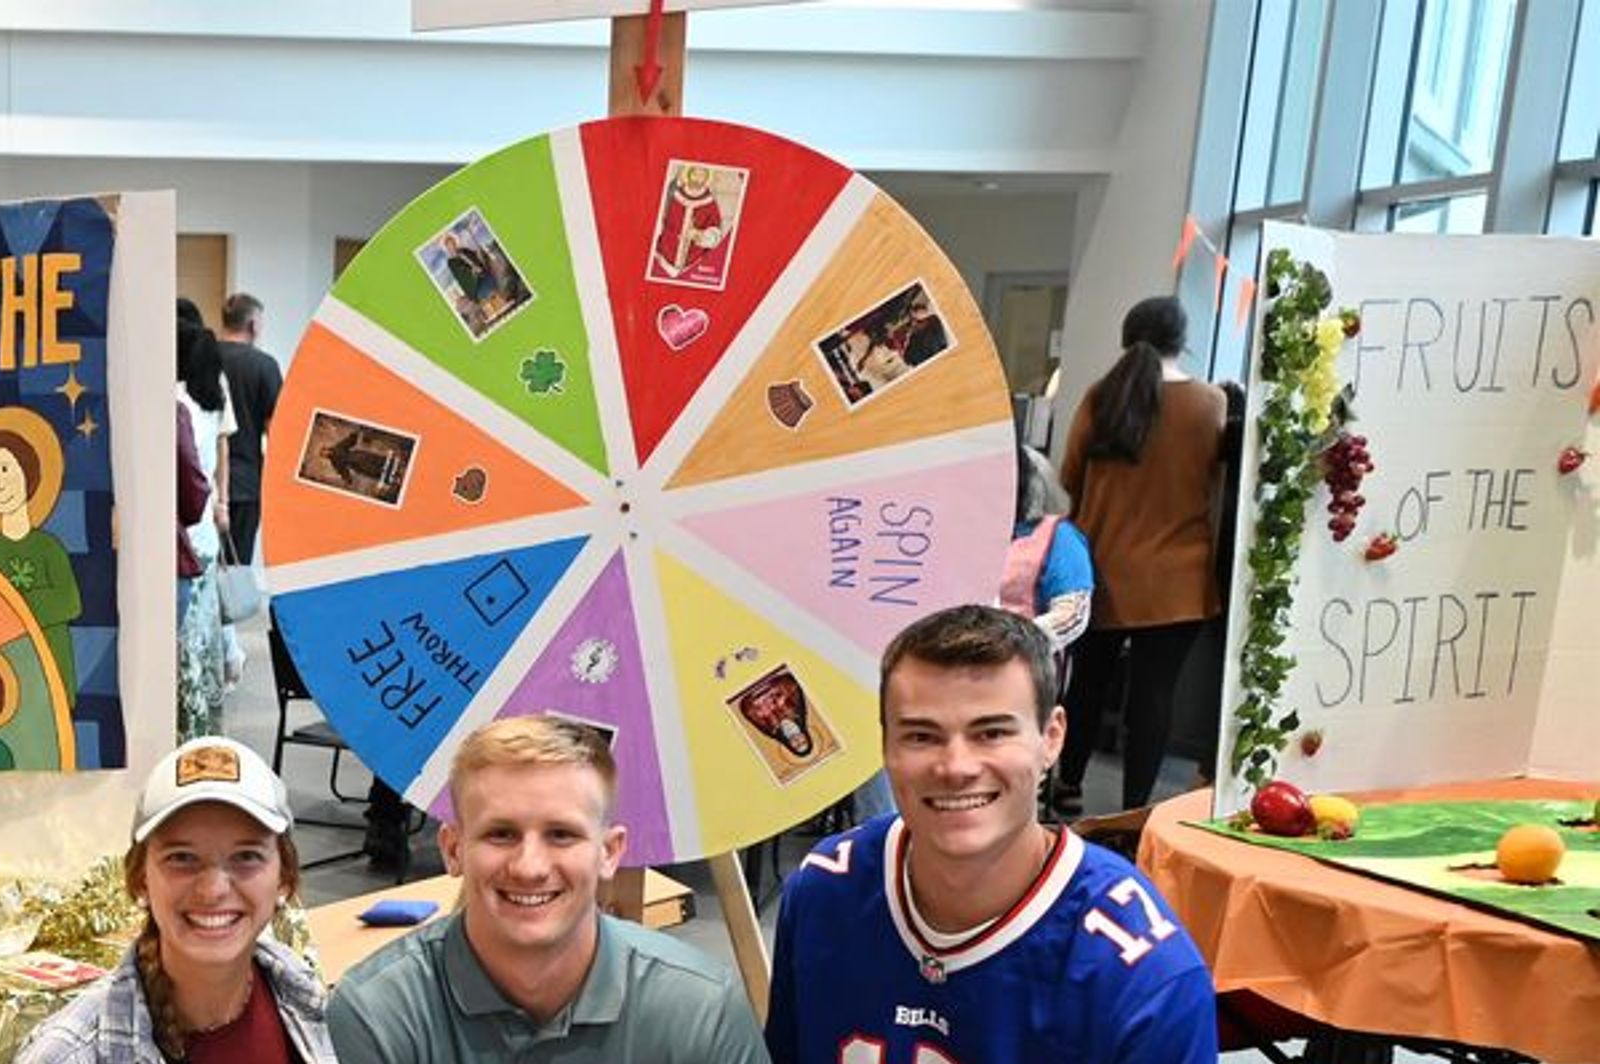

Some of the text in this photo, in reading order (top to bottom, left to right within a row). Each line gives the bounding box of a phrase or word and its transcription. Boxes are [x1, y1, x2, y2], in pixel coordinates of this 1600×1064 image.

[1353, 294, 1595, 398] FRUITS
[827, 498, 862, 588] AGAIN
[1394, 469, 1536, 541] OF THE
[869, 501, 933, 606] SPIN
[346, 620, 443, 730] FREE
[400, 611, 480, 694] THROW
[1315, 591, 1536, 709] SPIRIT
[799, 838, 854, 874] 7
[1083, 876, 1177, 967] 17
